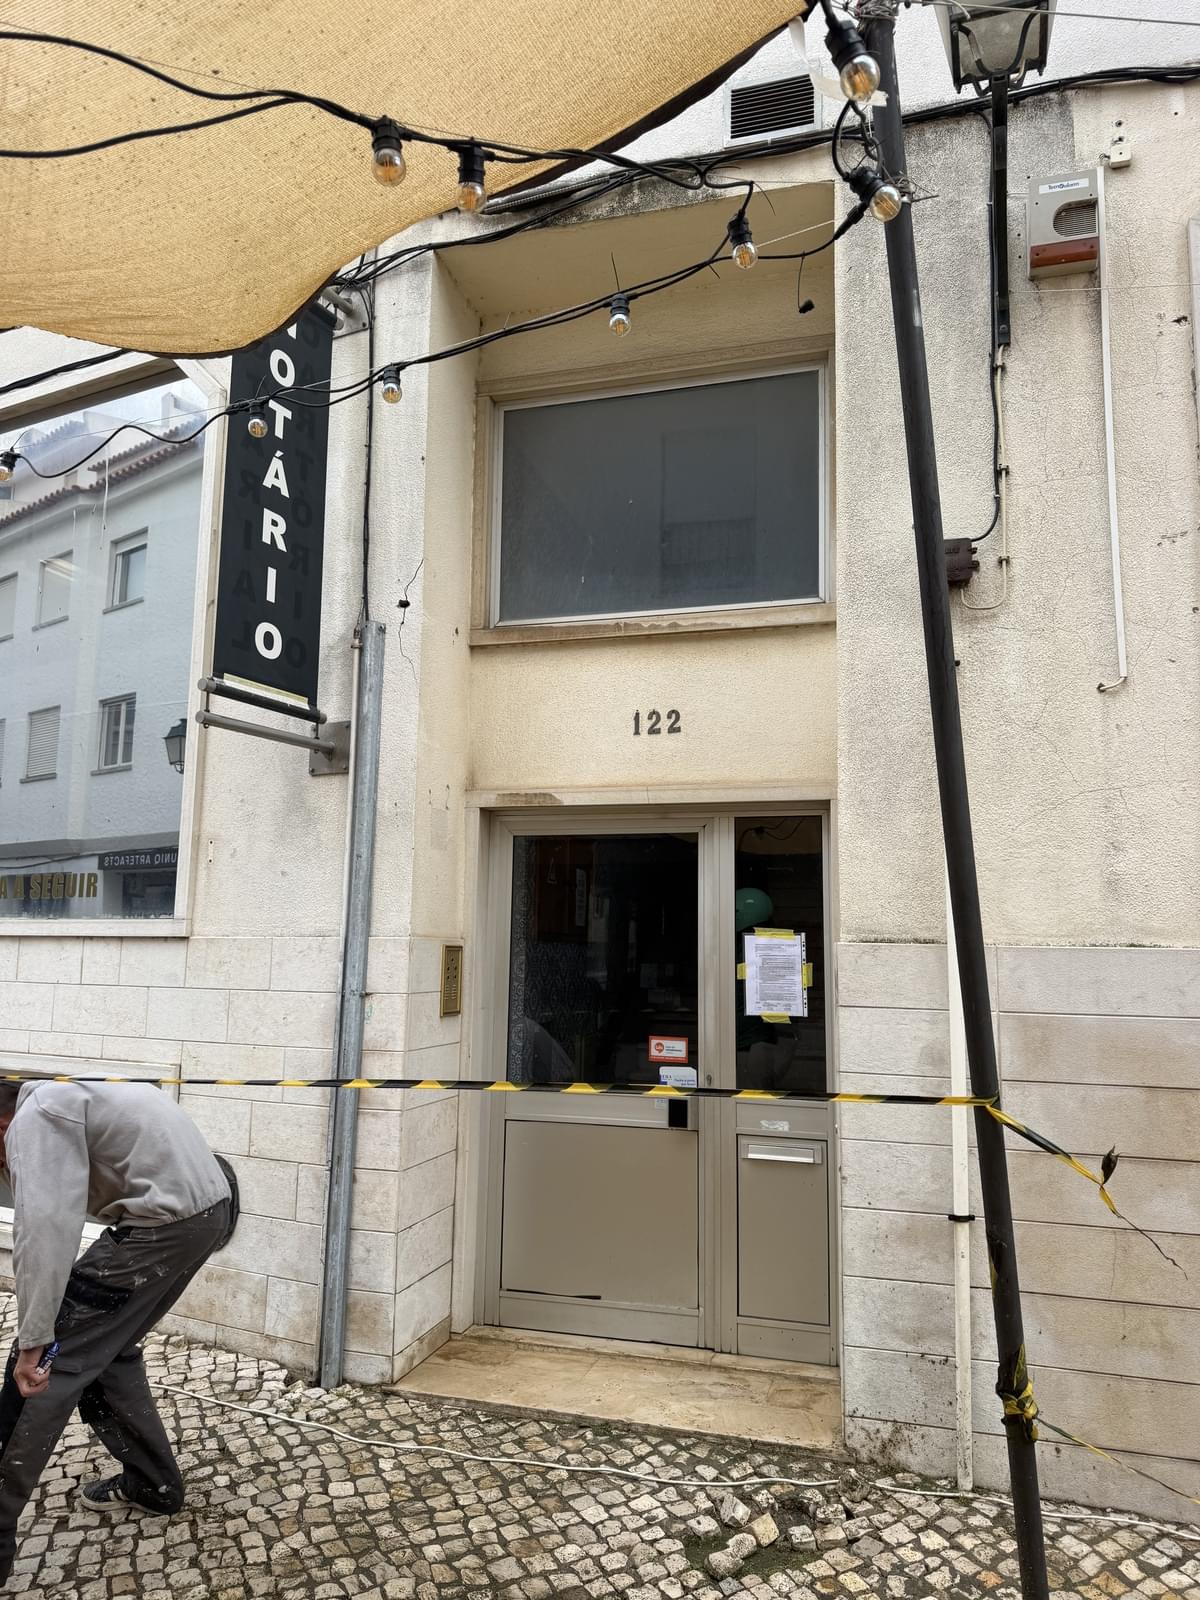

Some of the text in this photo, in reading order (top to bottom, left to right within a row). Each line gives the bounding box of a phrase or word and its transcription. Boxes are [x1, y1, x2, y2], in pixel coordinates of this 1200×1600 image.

[633, 709, 681, 735] 122
[13, 873, 25, 899] A
[30, 872, 97, 899] SEGUIR
